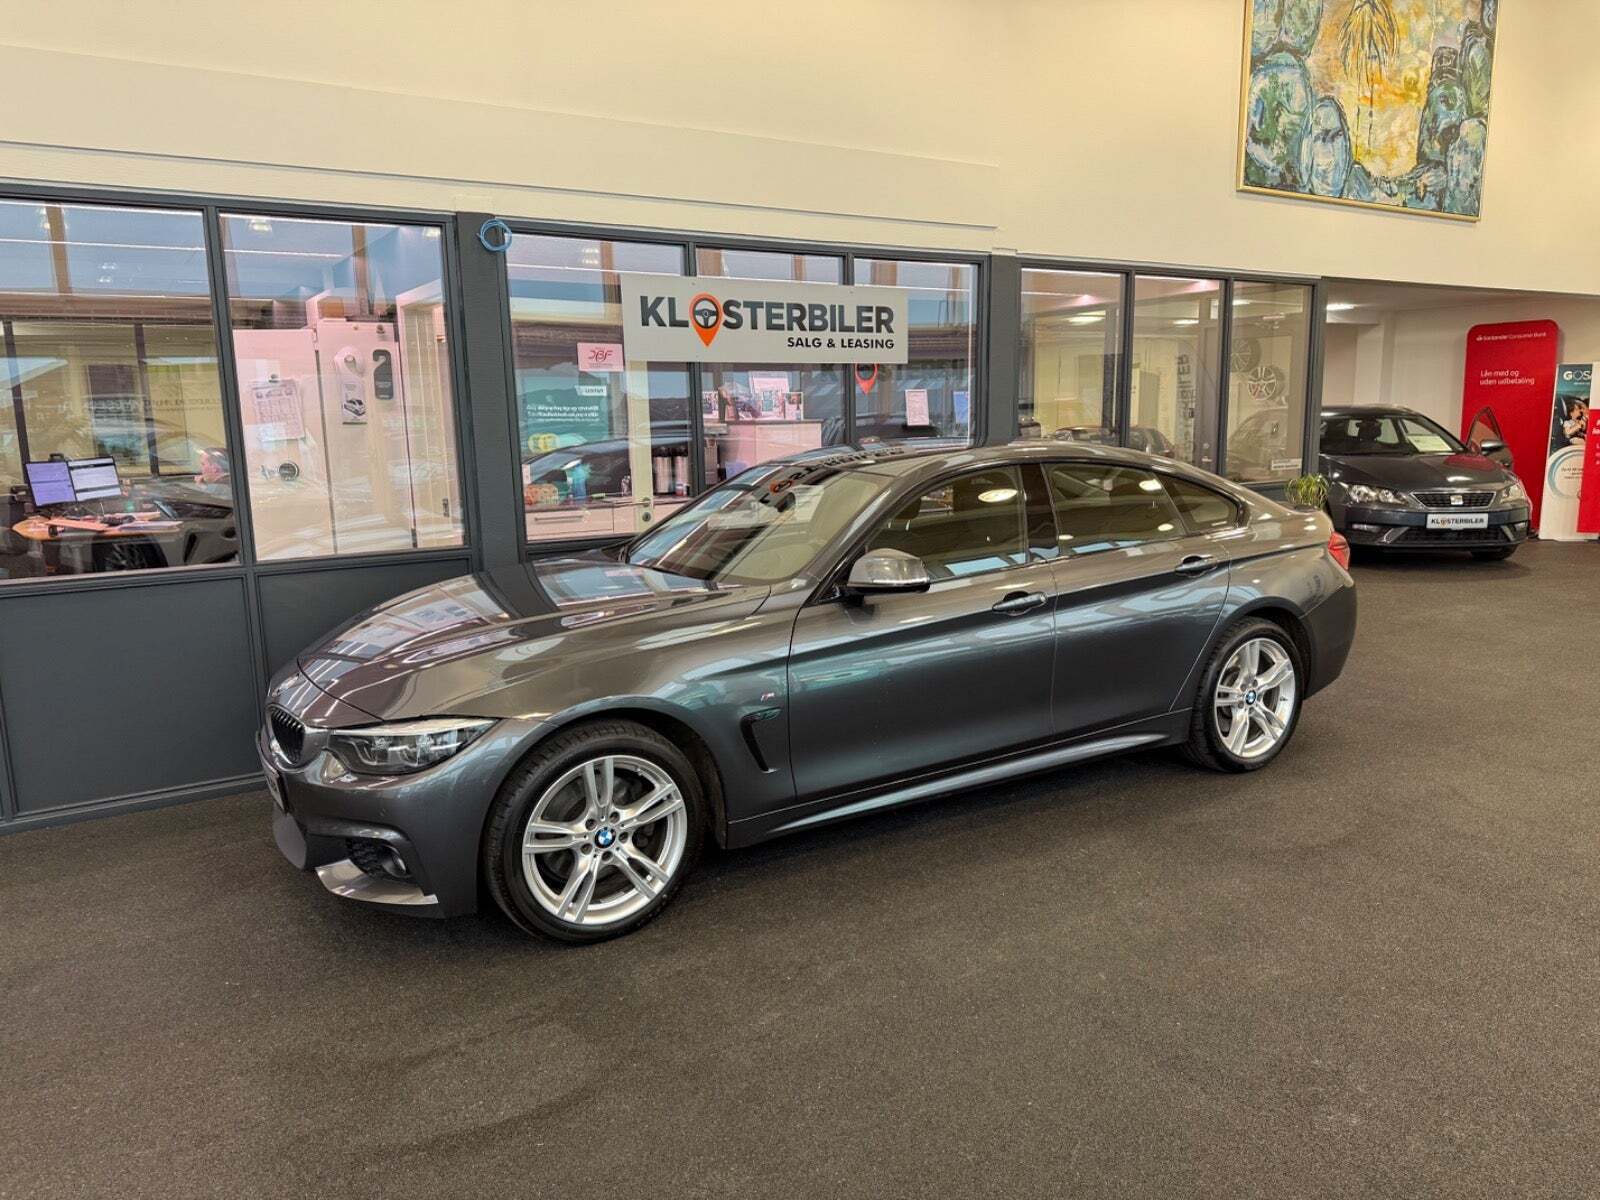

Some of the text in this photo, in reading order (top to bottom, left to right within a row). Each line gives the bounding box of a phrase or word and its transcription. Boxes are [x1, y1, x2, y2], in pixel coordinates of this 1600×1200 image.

[640, 294, 894, 338] KLOSTERBILER
[787, 337, 895, 350] SALG & LEASING
[1498, 377, 1535, 386] udbetaling
